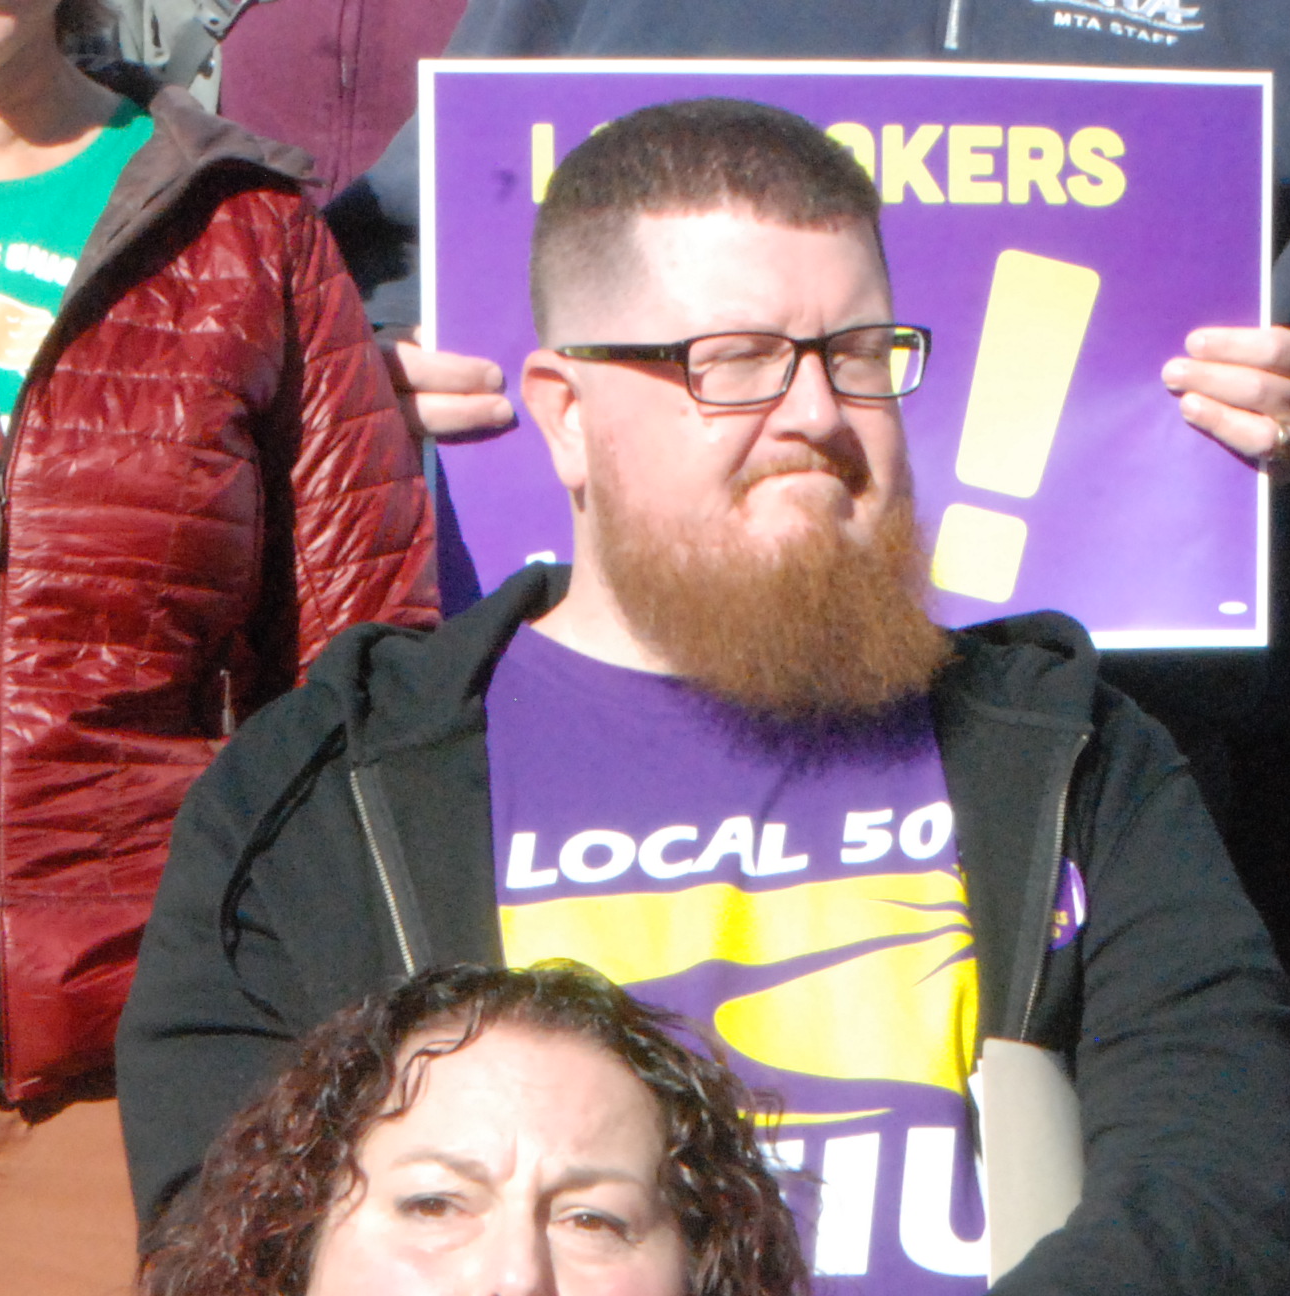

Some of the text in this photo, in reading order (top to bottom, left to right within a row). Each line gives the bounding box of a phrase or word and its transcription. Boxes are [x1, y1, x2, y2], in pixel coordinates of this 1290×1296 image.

[1053, 11, 1102, 31] MTA
[1110, 21, 1179, 46] STAFF
[506, 802, 953, 889] LOCAL 50
